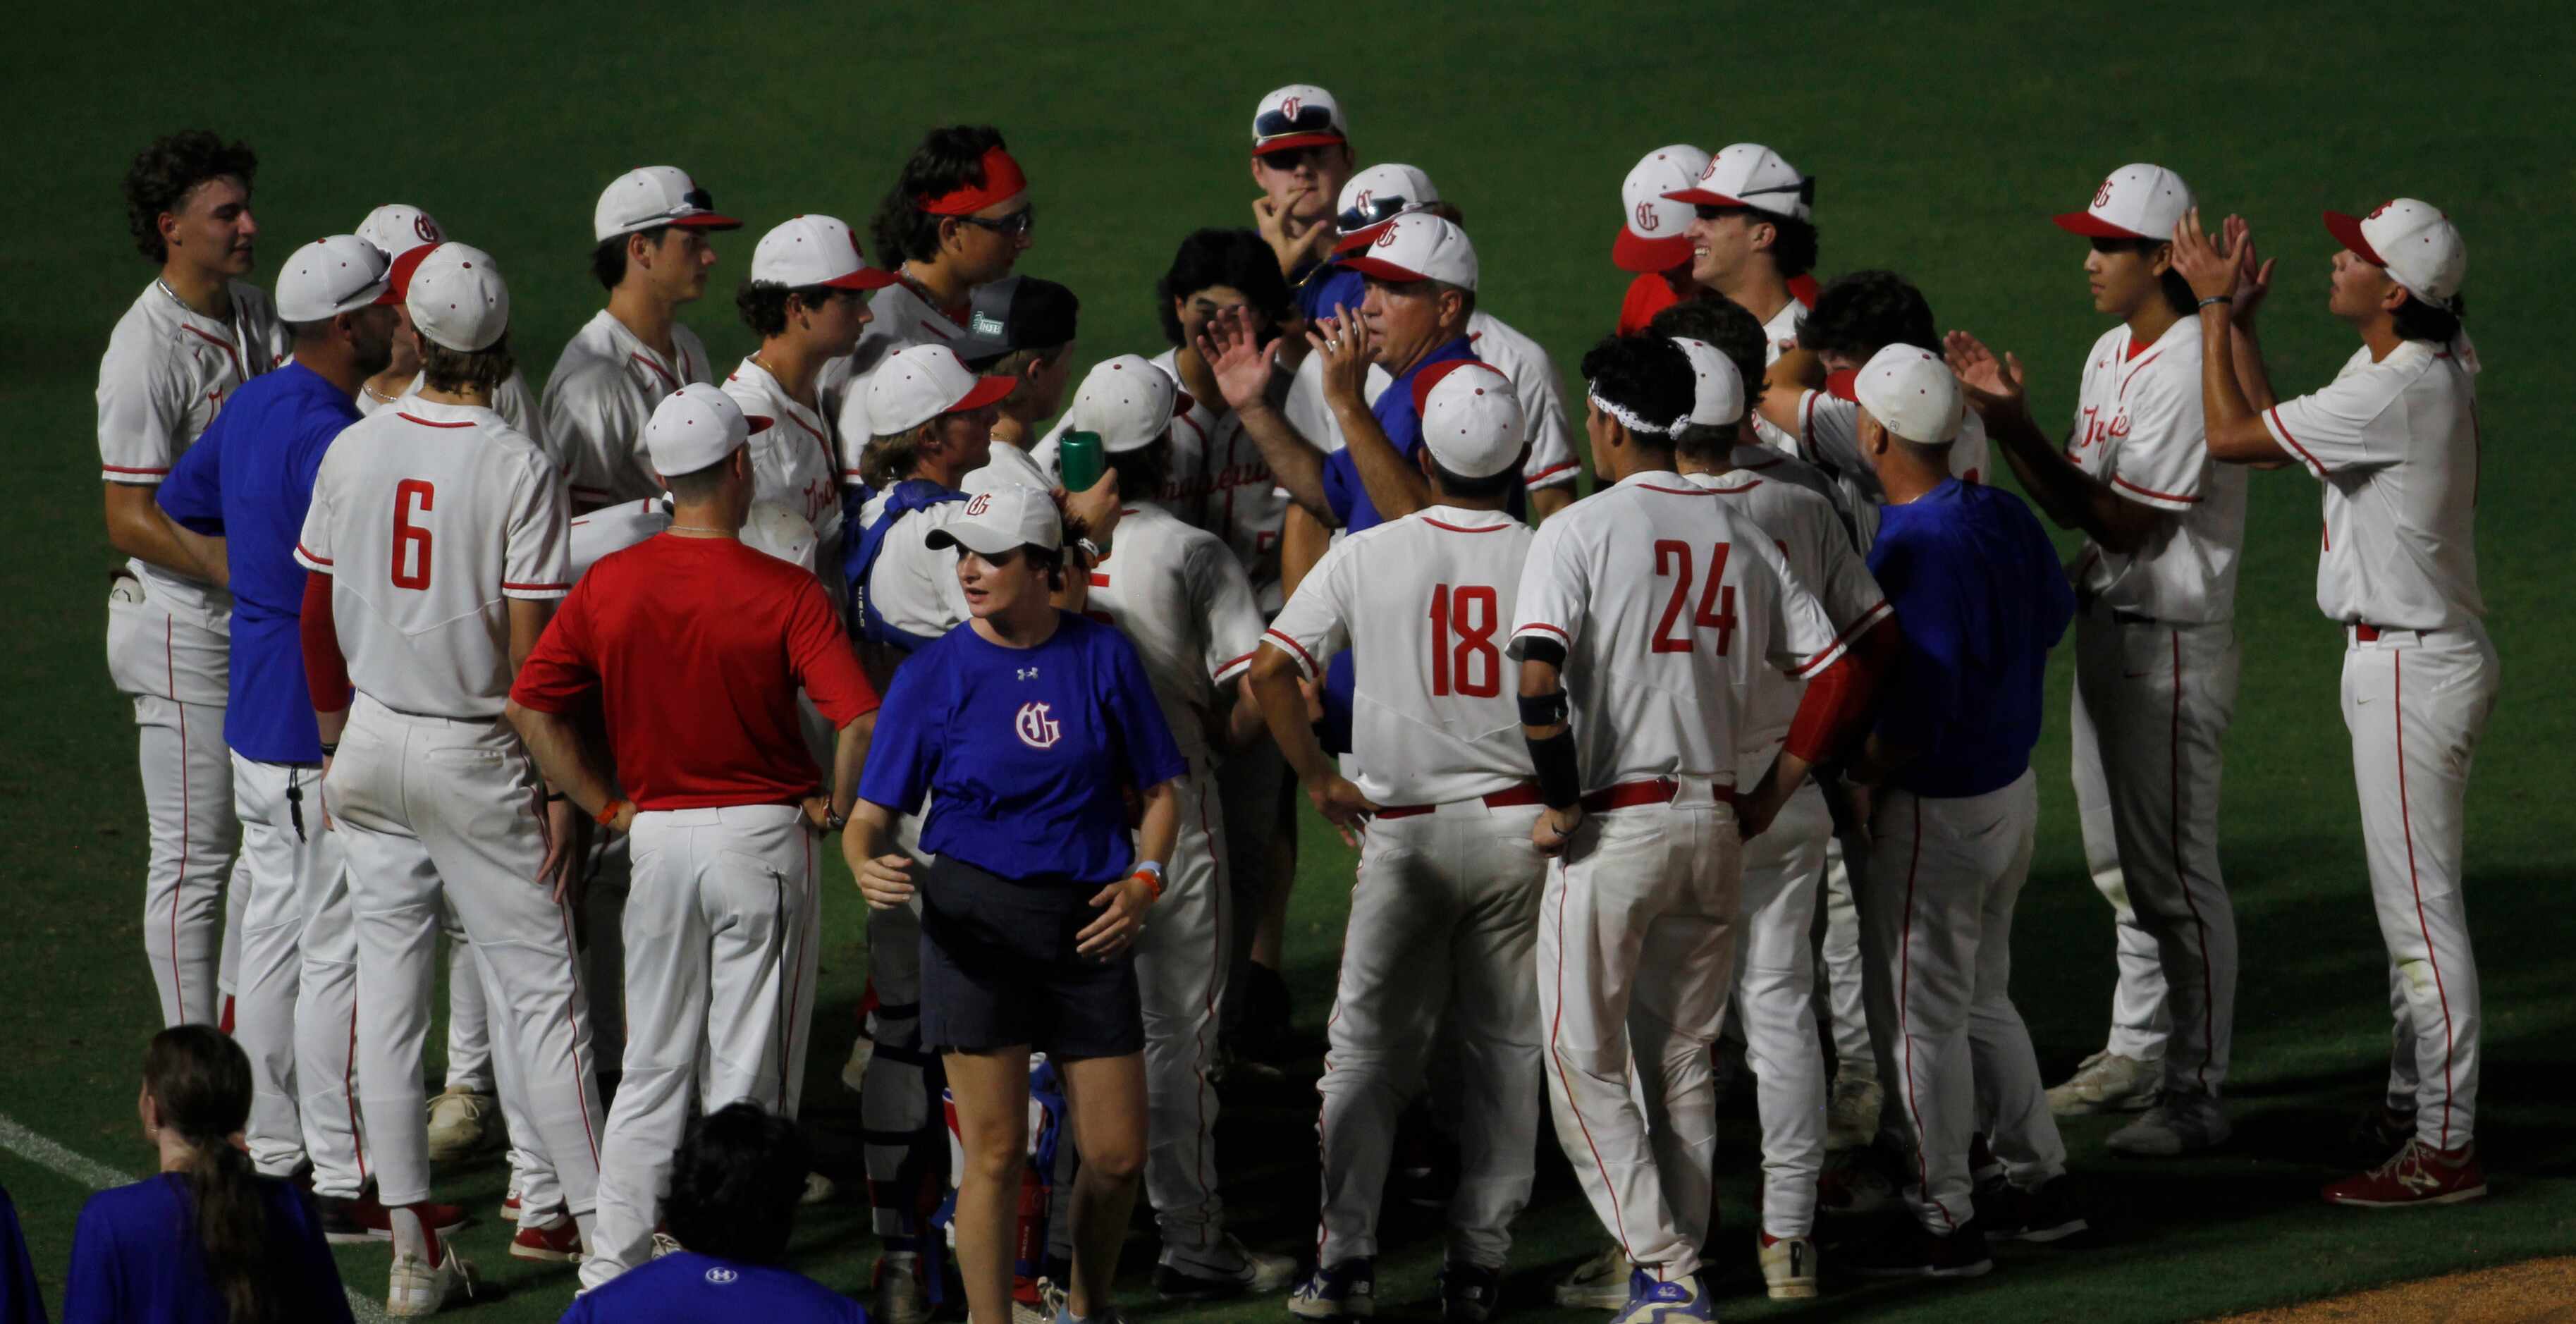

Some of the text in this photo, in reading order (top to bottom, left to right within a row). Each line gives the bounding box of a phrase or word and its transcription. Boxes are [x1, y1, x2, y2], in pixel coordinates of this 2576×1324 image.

[1636, 201, 1658, 231] G
[967, 494, 991, 515] G
[391, 478, 434, 591] 6
[1652, 539, 1736, 656] 24
[1429, 583, 1500, 698] 18
[1015, 701, 1061, 749] G
[1658, 1287, 1677, 1297] 42
